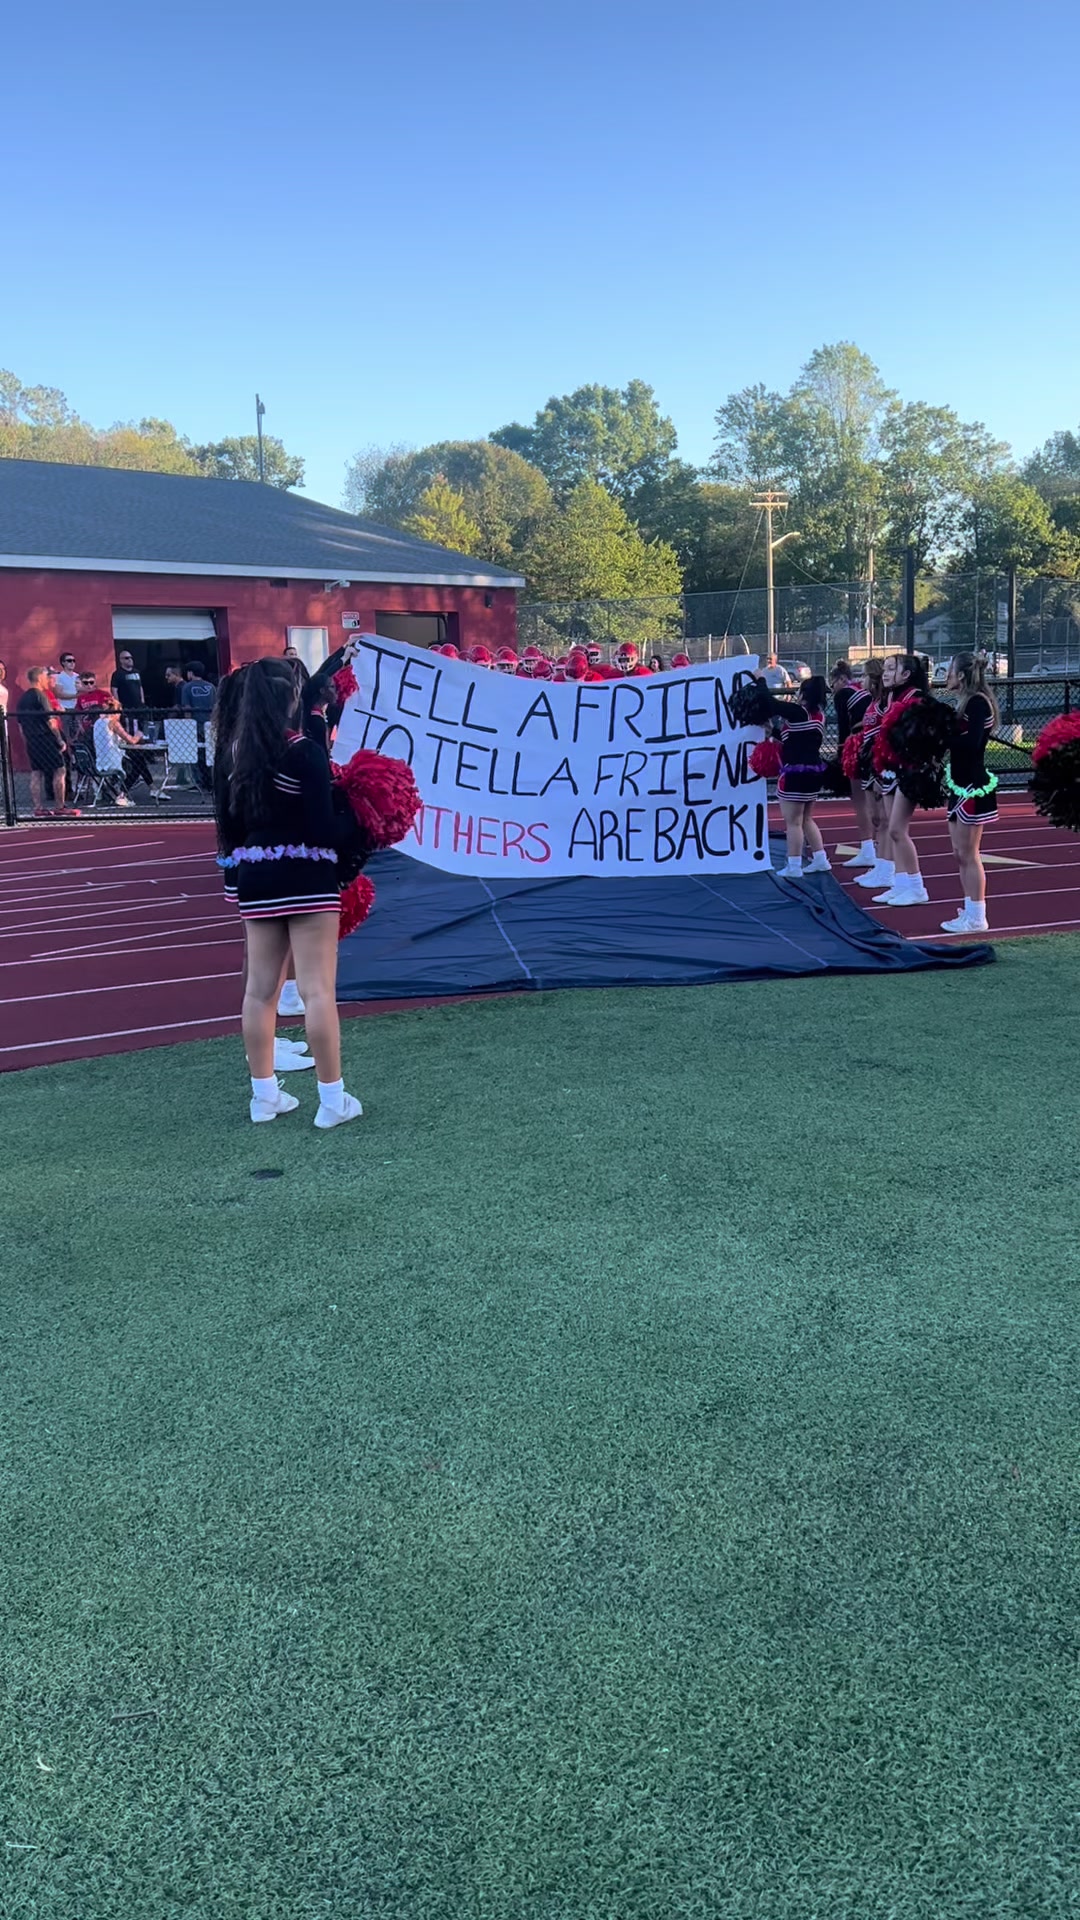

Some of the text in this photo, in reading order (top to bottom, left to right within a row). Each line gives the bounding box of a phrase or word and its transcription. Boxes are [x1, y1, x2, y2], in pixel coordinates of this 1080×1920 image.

[358, 640, 498, 734] TELL
[516, 690, 559, 740] A
[426, 732, 538, 796] TELL
[540, 757, 579, 796] A
[594, 741, 762, 806] FRIEND
[412, 803, 765, 863] NTHERS ARE BACK!
